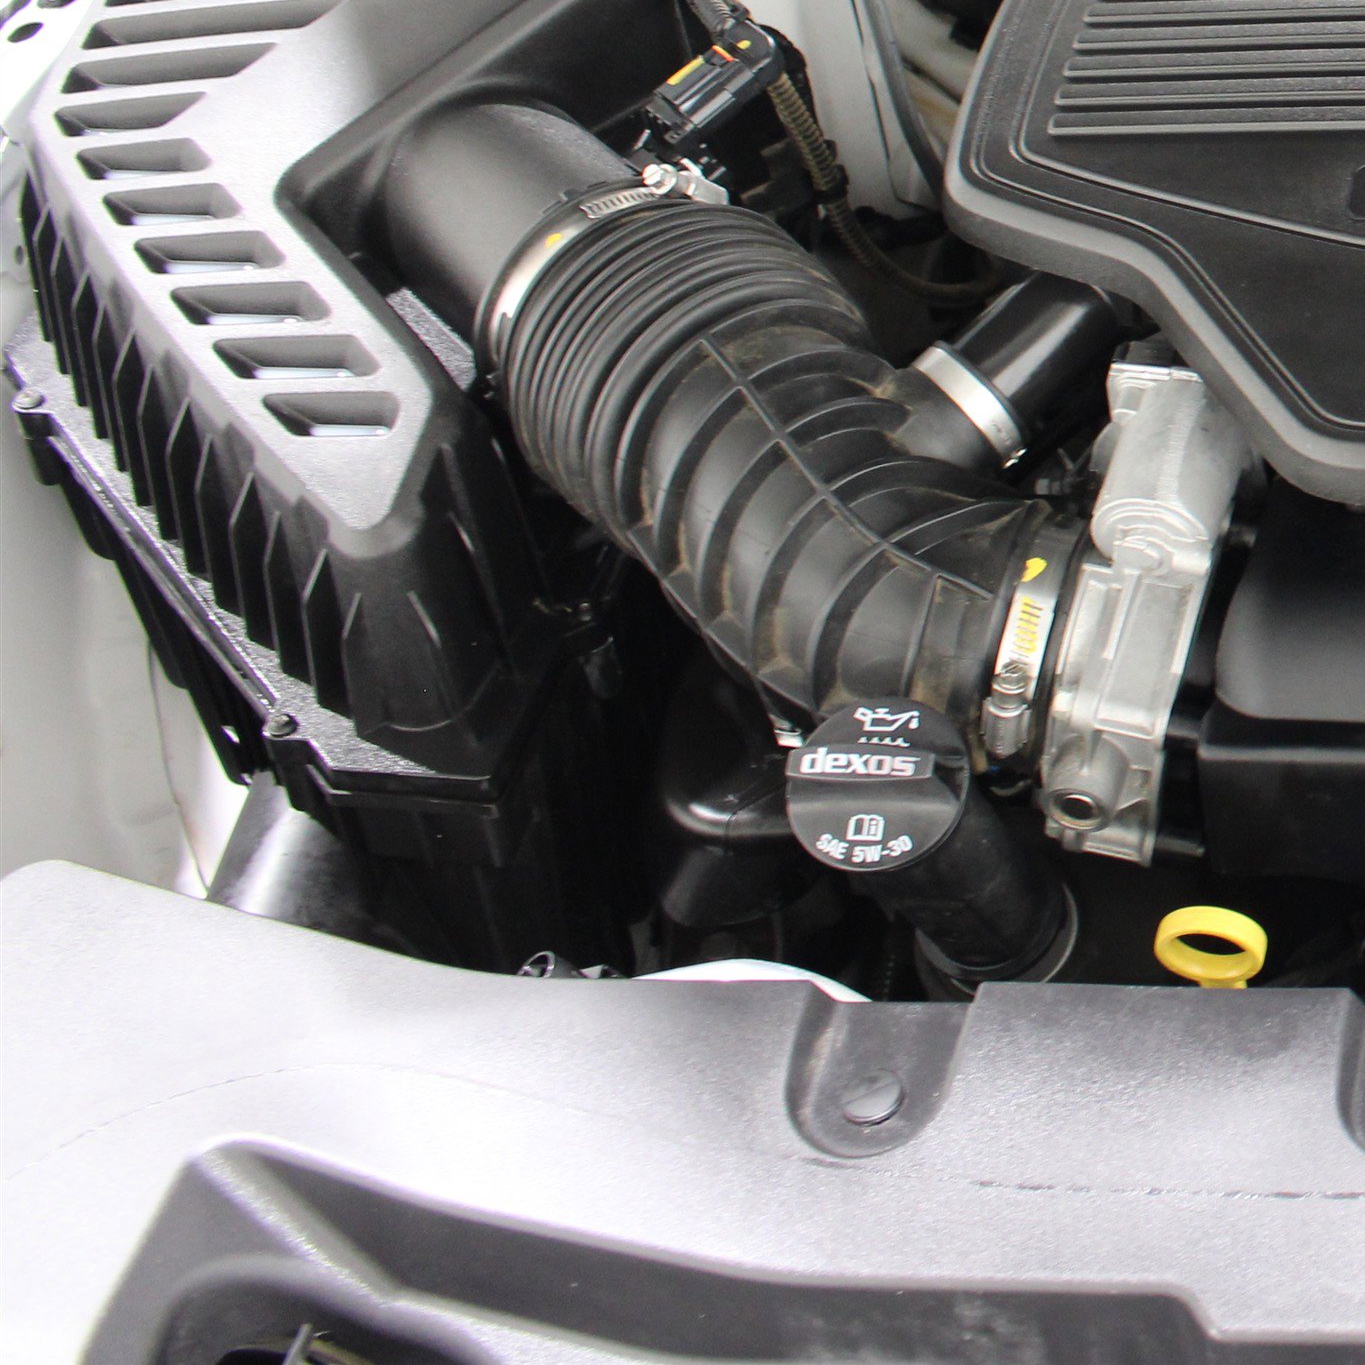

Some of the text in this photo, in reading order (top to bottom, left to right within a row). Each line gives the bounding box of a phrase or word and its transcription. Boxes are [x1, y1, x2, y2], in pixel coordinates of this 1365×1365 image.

[800, 747, 921, 776] dexos
[816, 833, 913, 863] SAE 5W-30
